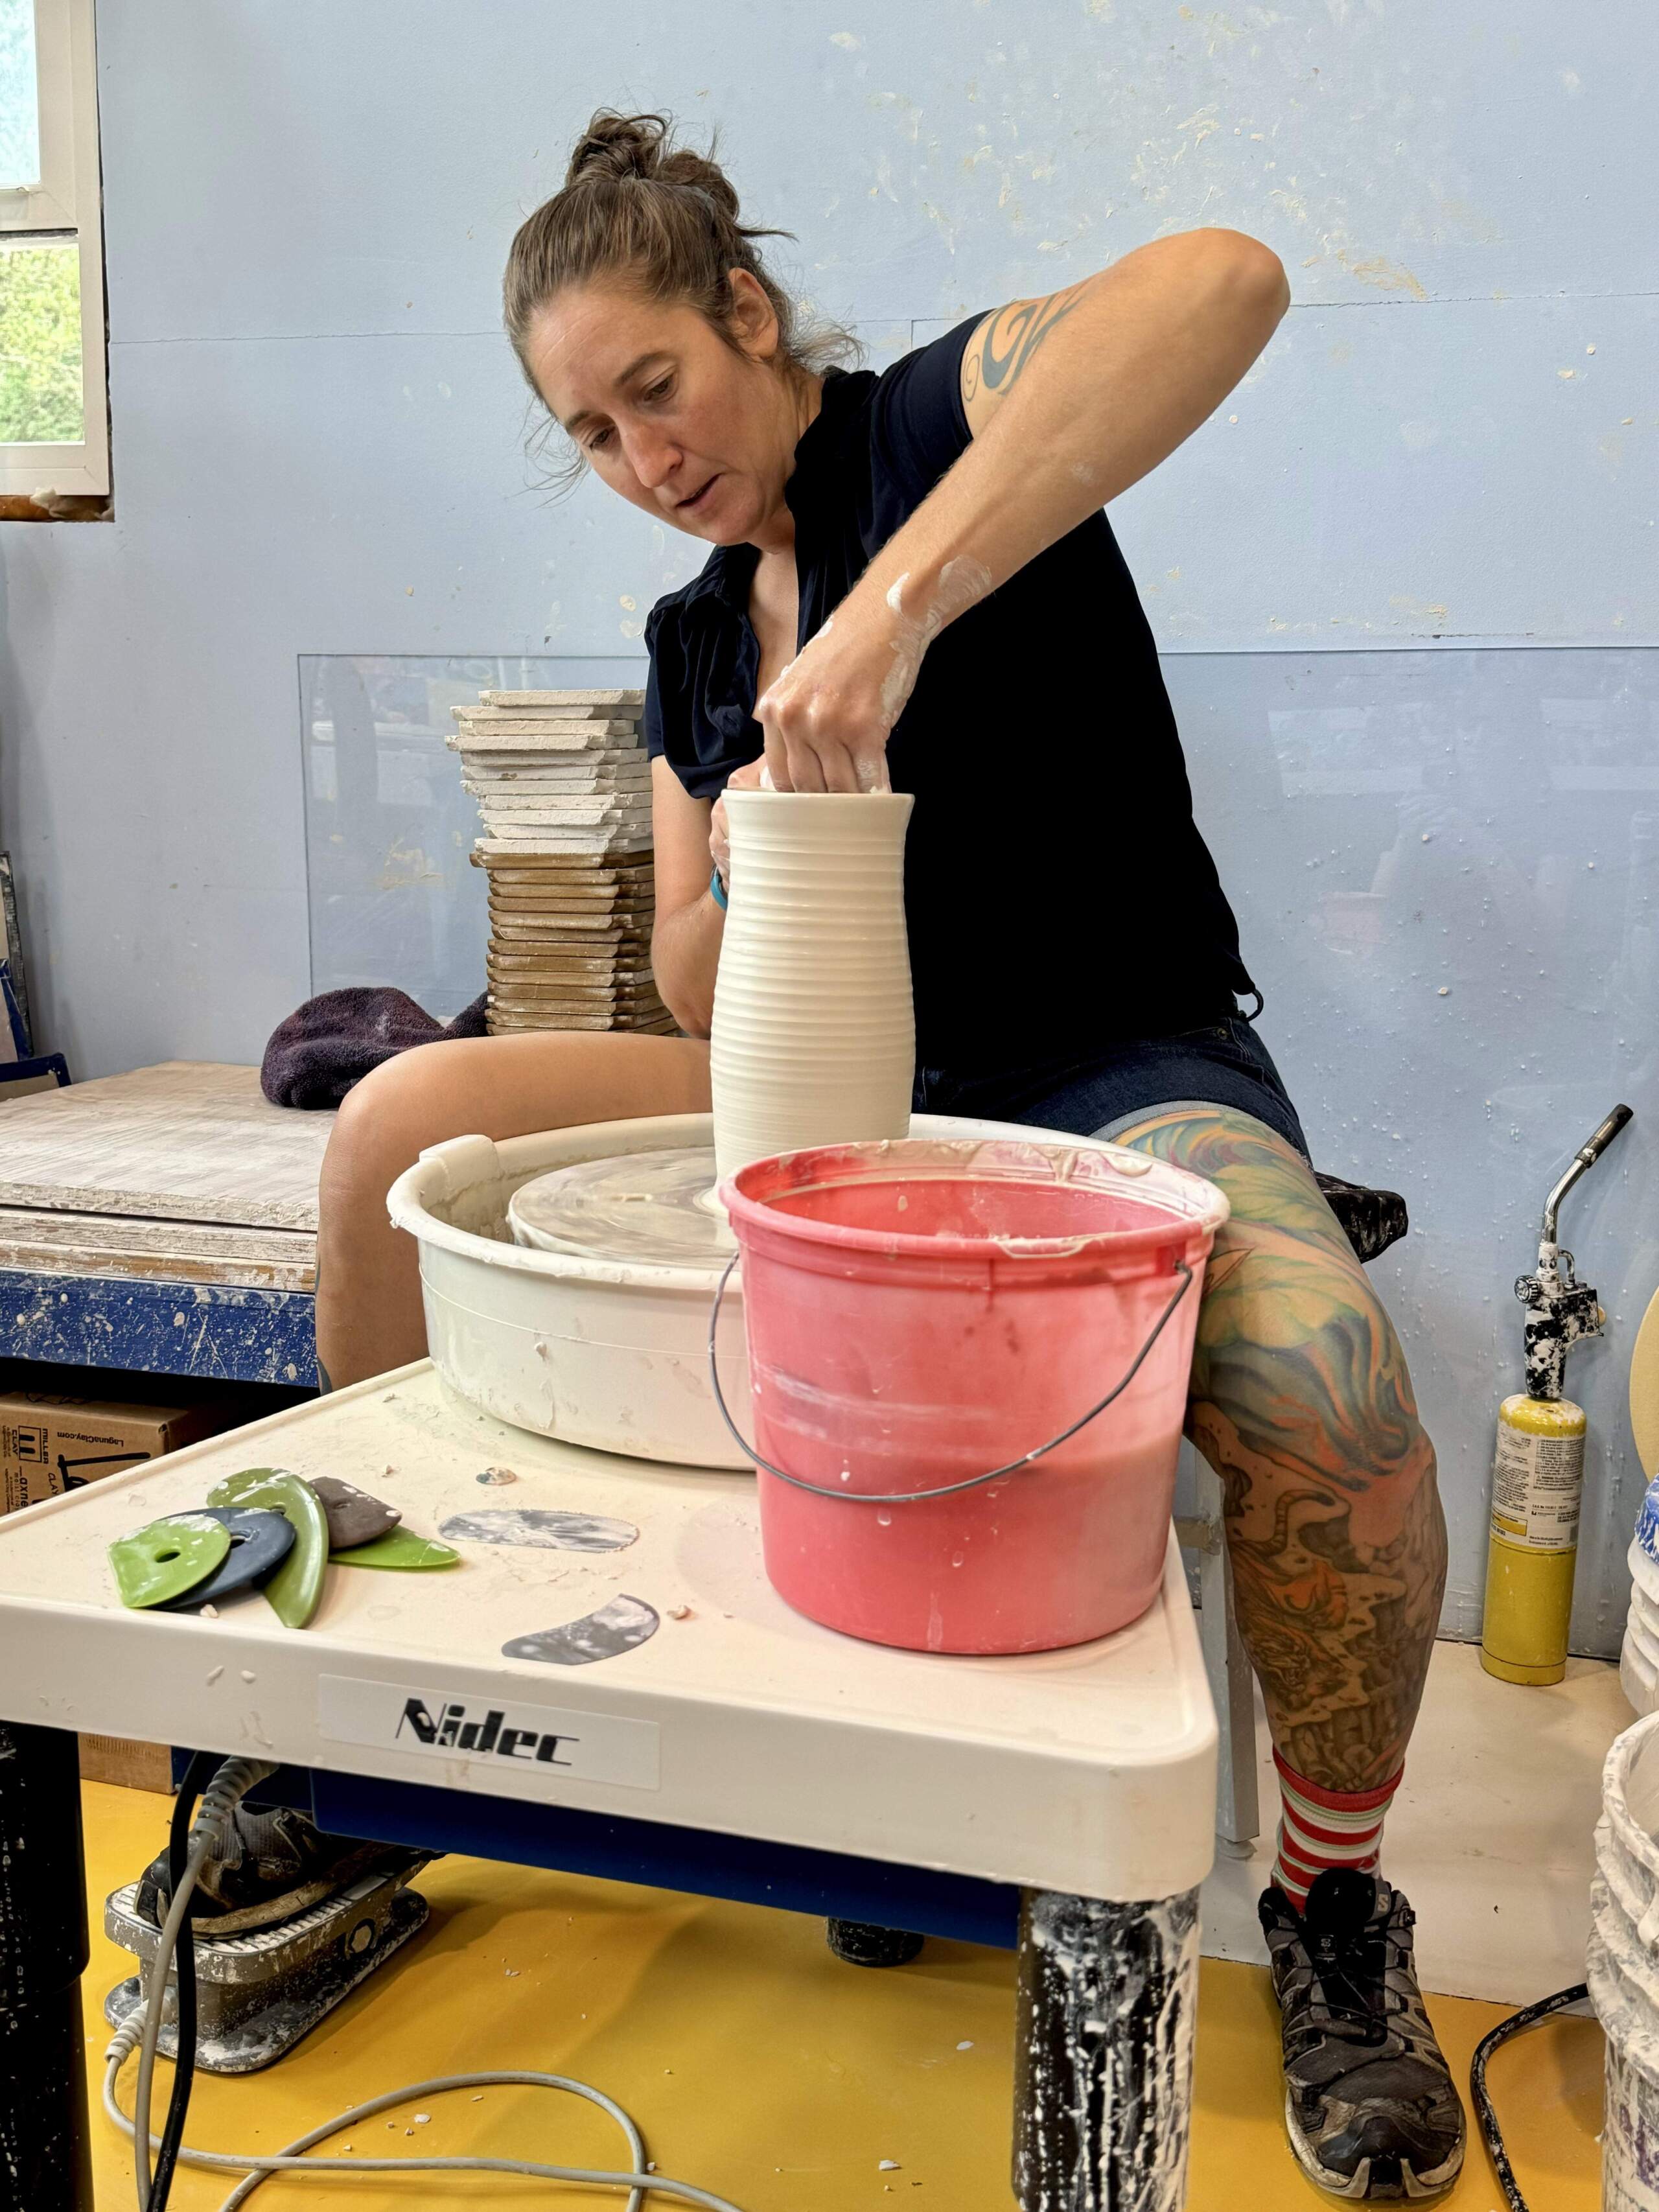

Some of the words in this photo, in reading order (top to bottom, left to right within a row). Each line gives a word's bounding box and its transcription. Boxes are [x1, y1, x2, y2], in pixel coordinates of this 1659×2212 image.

[57, 1432, 124, 1447] LagunaClay.com
[19, 1478, 29, 1508] axne
[48, 1473, 60, 1495] CLAY
[395, 1697, 580, 1766] Nidec
